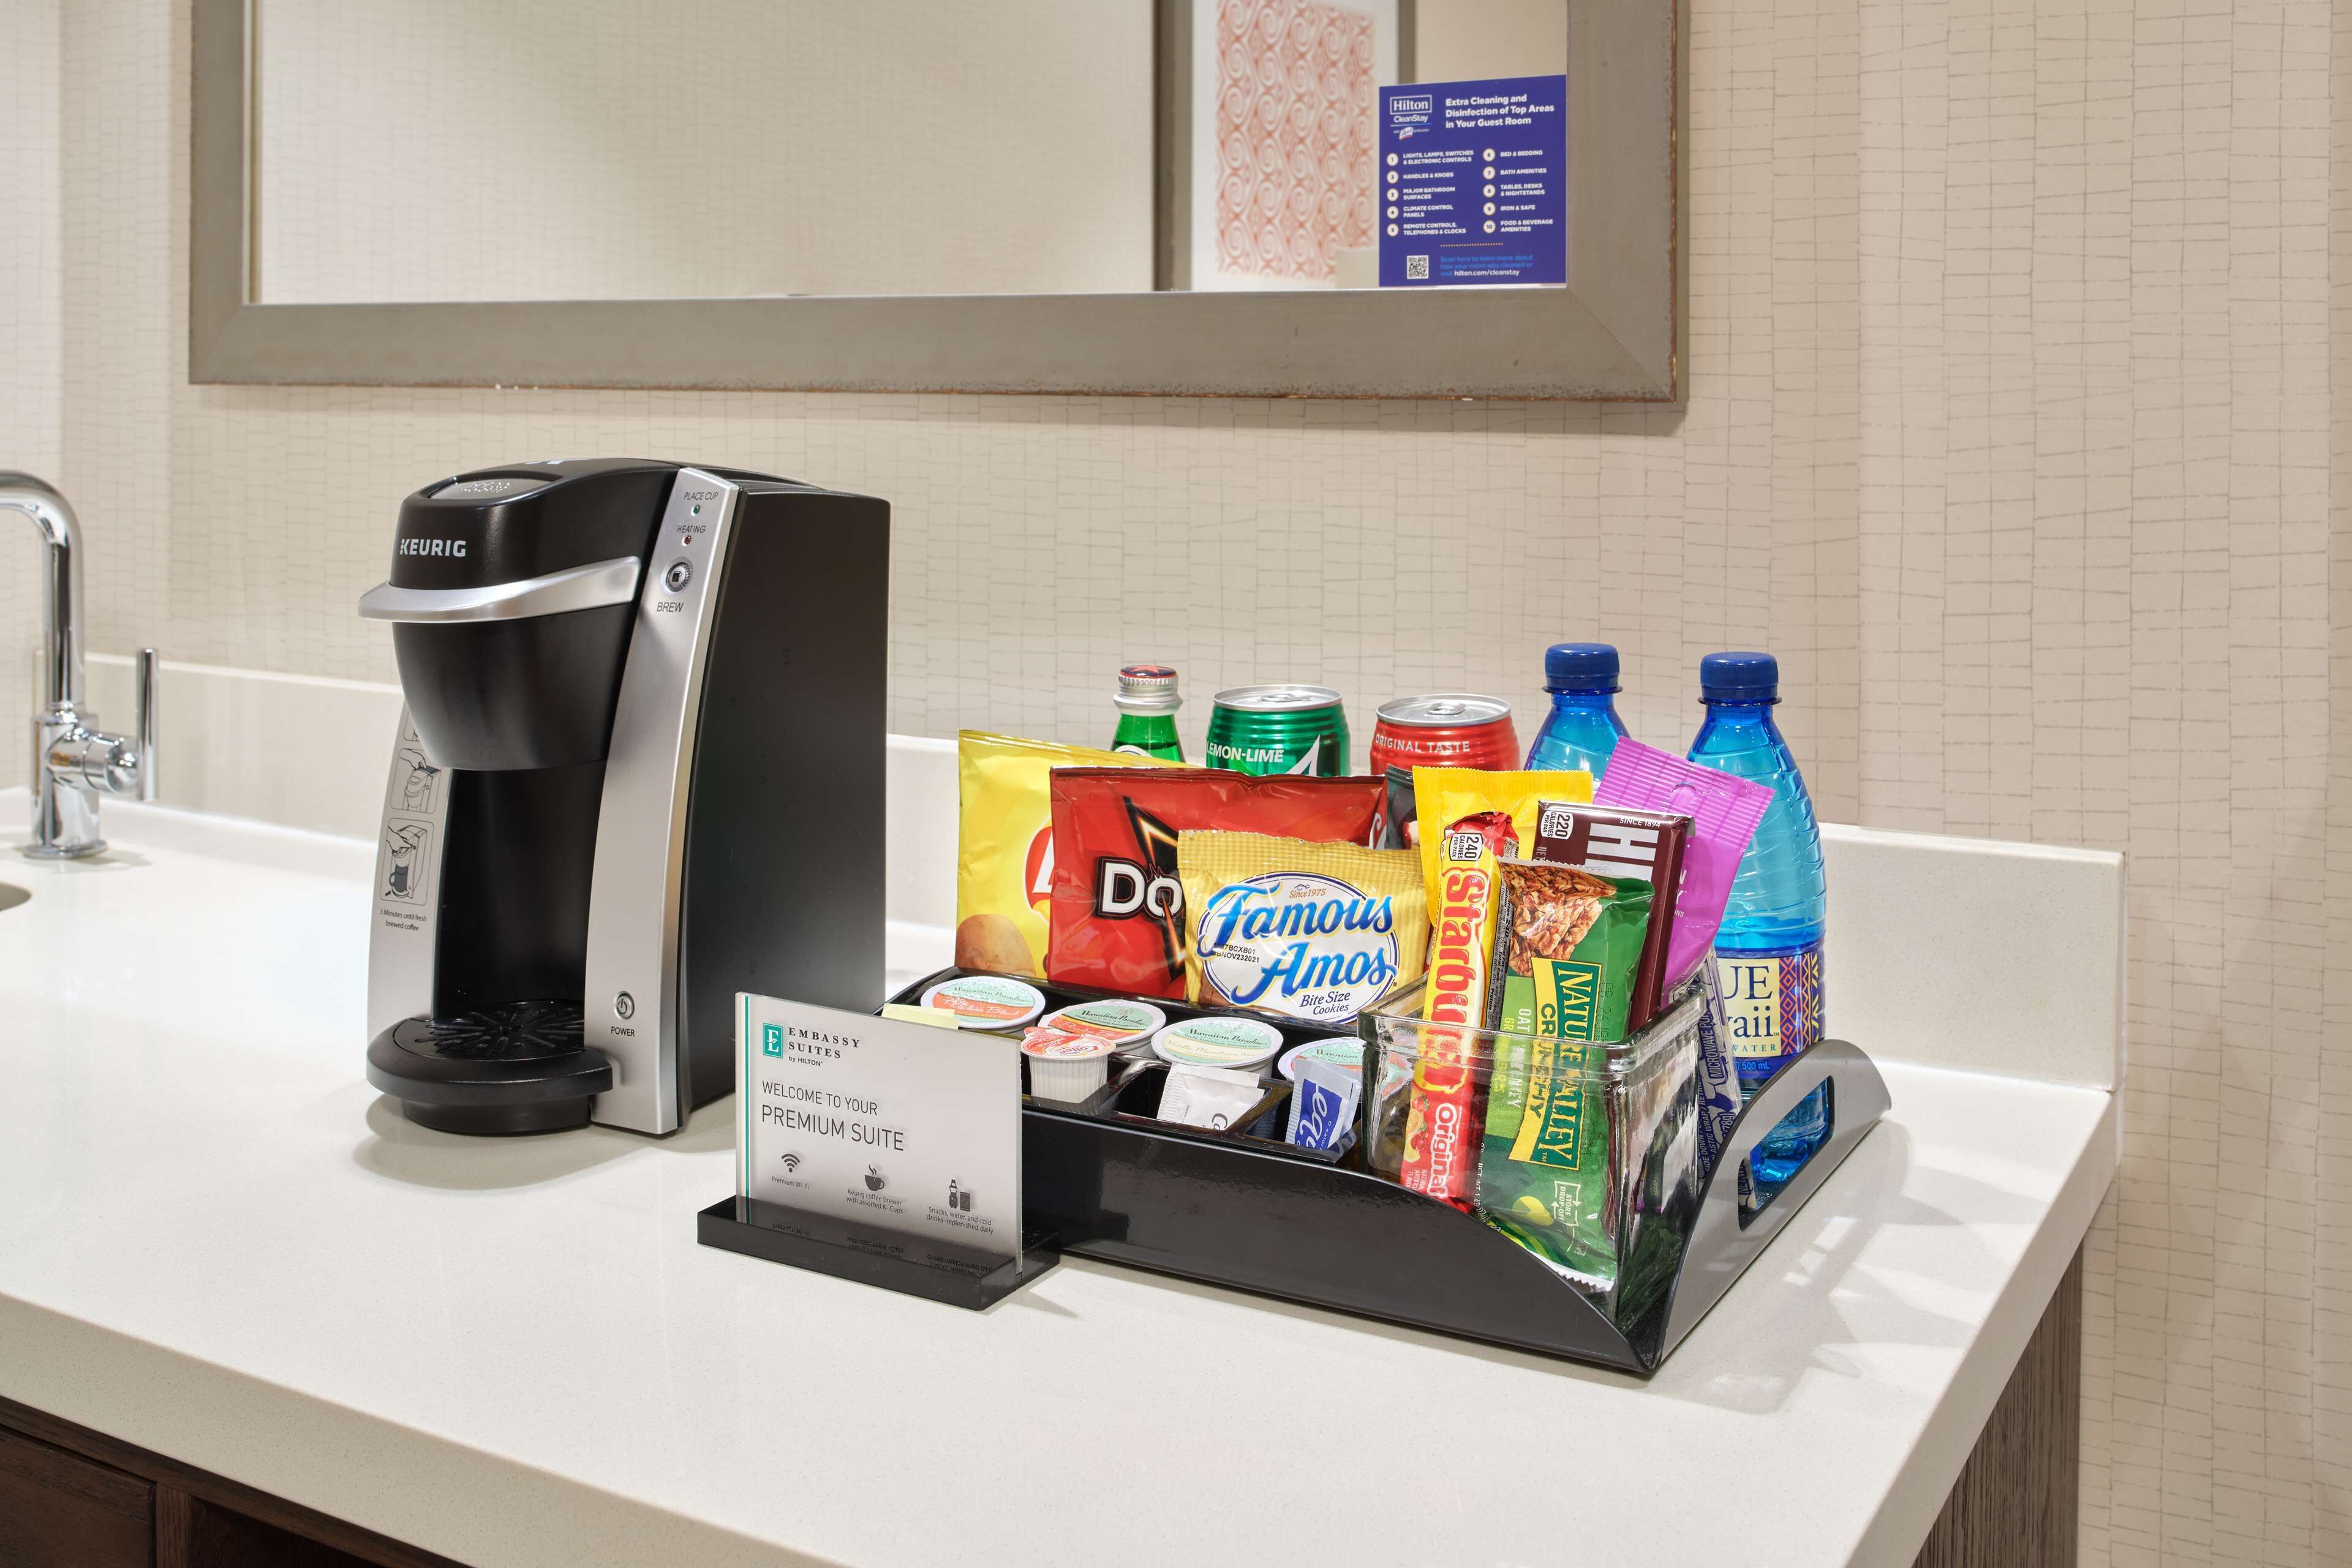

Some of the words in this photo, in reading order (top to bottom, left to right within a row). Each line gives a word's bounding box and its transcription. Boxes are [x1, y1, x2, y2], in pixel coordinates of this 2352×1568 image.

[1393, 100, 1428, 111] Hilton
[1471, 96, 1509, 105] Cleaning
[1446, 107, 1498, 118] Disinfection
[1510, 106, 1526, 115] Top
[1528, 104, 1555, 113] Areas
[1477, 118, 1503, 127] Guest
[1505, 116, 1531, 125] Room
[399, 538, 466, 557] KEURIG
[657, 601, 684, 612] BREW
[1207, 741, 1284, 763] LEMON-LIME
[1376, 734, 1422, 752] ORIGINAL
[1427, 741, 1471, 753] TASTE
[1547, 812, 1557, 837] CALORIES
[1555, 813, 1571, 838] 220
[1619, 817, 1642, 826] SINCE
[1645, 819, 1661, 828] 1894
[1464, 836, 1479, 859] 240
[383, 909, 402, 918] Minutes
[1197, 881, 1393, 958] Famous
[386, 920, 404, 929] brewed
[1230, 942, 1397, 1005] Amos
[1724, 966, 1773, 1000] UE
[1300, 992, 1324, 1008] Bite
[1327, 990, 1351, 1003] Size
[1081, 1010, 1118, 1020] Hawaiian
[1313, 1003, 1349, 1016] Cookies
[1517, 1008, 1531, 1033] OAT
[611, 1026, 635, 1037] POWER
[788, 1027, 860, 1048] EMBASSY
[1190, 1028, 1229, 1039] Hawaiian
[789, 1041, 841, 1059] SUITES
[1701, 1030, 1722, 1077] MICROWAVE
[1741, 1061, 1756, 1070] 500
[1758, 1061, 1771, 1069] mL
[762, 1080, 823, 1105] WELCOME
[826, 1093, 840, 1108] TO
[845, 1097, 877, 1116] YOUR
[762, 1104, 844, 1139] PREMIUM
[851, 1123, 903, 1152] SUITE
[1702, 1112, 1712, 1132] WRAP
[1427, 1104, 1457, 1197] Original
[772, 1176, 794, 1186] Premium
[796, 1181, 810, 1189] Wi-Fi
[847, 1188, 864, 1199] Keurig
[865, 1193, 883, 1202] coffee
[883, 1196, 902, 1206] brewer
[859, 1199, 881, 1210] assorted
[929, 1206, 949, 1217] Snacks,
[949, 1212, 967, 1221] water,
[980, 1225, 993, 1235] daily
